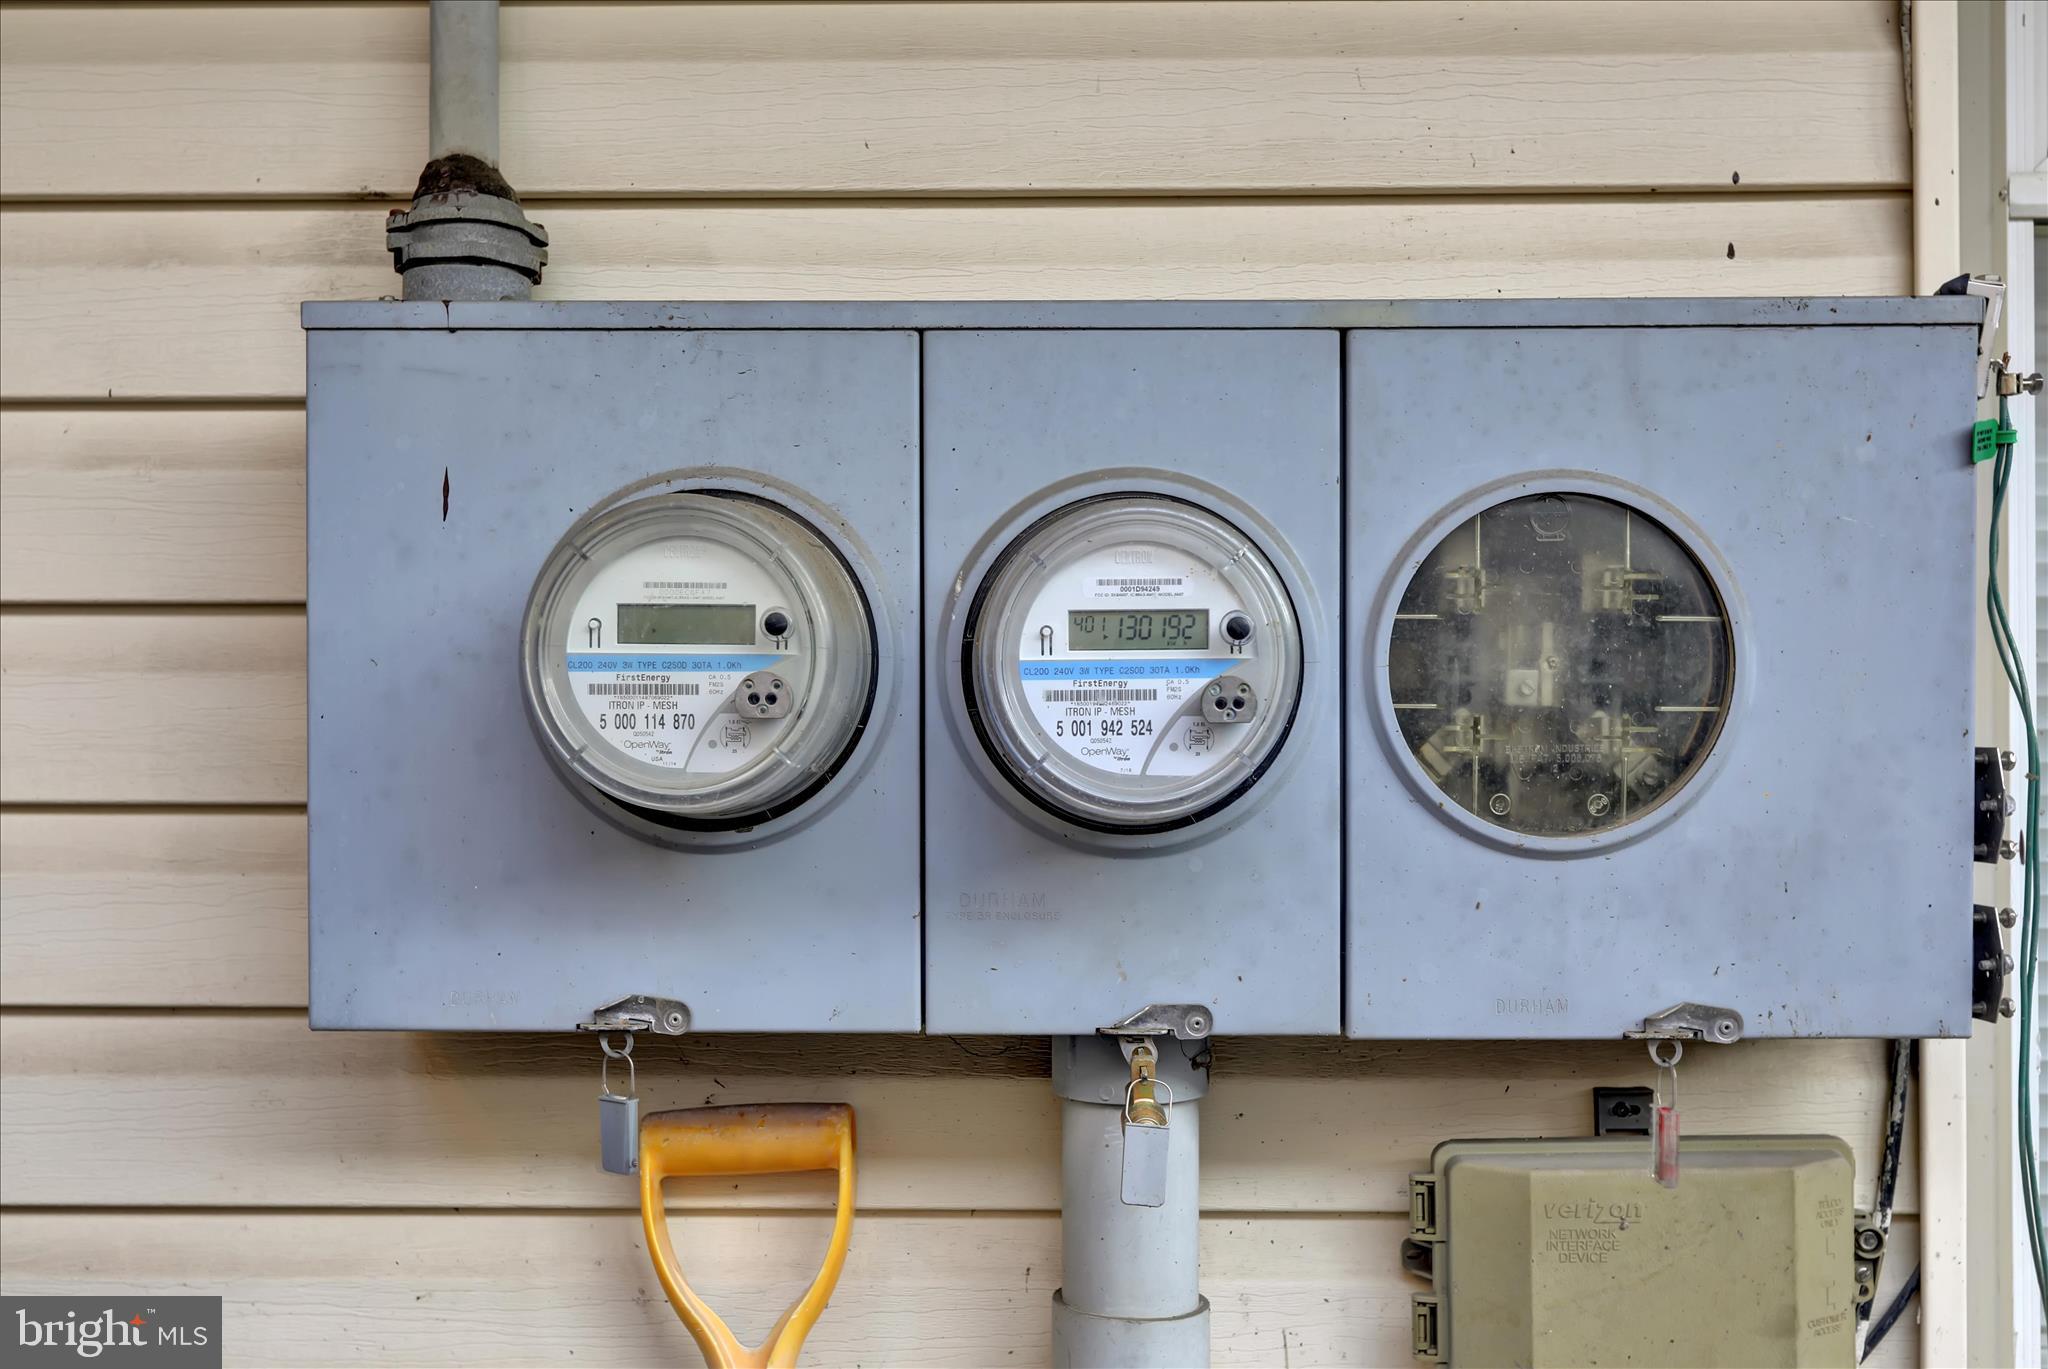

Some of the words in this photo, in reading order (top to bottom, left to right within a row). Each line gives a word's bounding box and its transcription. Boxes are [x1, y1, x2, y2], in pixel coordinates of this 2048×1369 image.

[567, 661, 593, 669] CL200
[597, 661, 618, 669] 240V
[637, 661, 657, 669] TYPE
[718, 661, 742, 669] 1.0Kh
[1023, 667, 1050, 676] CL200
[1054, 667, 1074, 675] 240V
[1094, 666, 1115, 675] TYPE
[616, 673, 671, 683] FirstEnergy
[1072, 680, 1128, 689] FirstEnergy
[608, 701, 635, 710] ITRON
[637, 701, 645, 710] IP
[652, 701, 678, 710] MESH
[1065, 707, 1091, 716] ITRON
[1094, 707, 1102, 716] IP
[1110, 707, 1136, 716] MESH
[599, 713, 607, 730] 5
[614, 713, 636, 730] 000
[644, 713, 666, 729] 114
[673, 713, 695, 730] 870
[1056, 720, 1064, 737] 5
[1071, 720, 1092, 736] 001
[1101, 719, 1123, 736] 942
[1130, 719, 1153, 736] 524
[623, 740, 670, 750] OpenWay
[1080, 747, 1128, 757] OpenWay
[959, 891, 1047, 908] DURHAM
[1495, 998, 1568, 1015] DURHAM
[1543, 1198, 1642, 1224] verizon
[1549, 1228, 1617, 1240] NETWORK
[1546, 1240, 1621, 1251] INTERFACE
[1558, 1252, 1608, 1264] DEVICE
